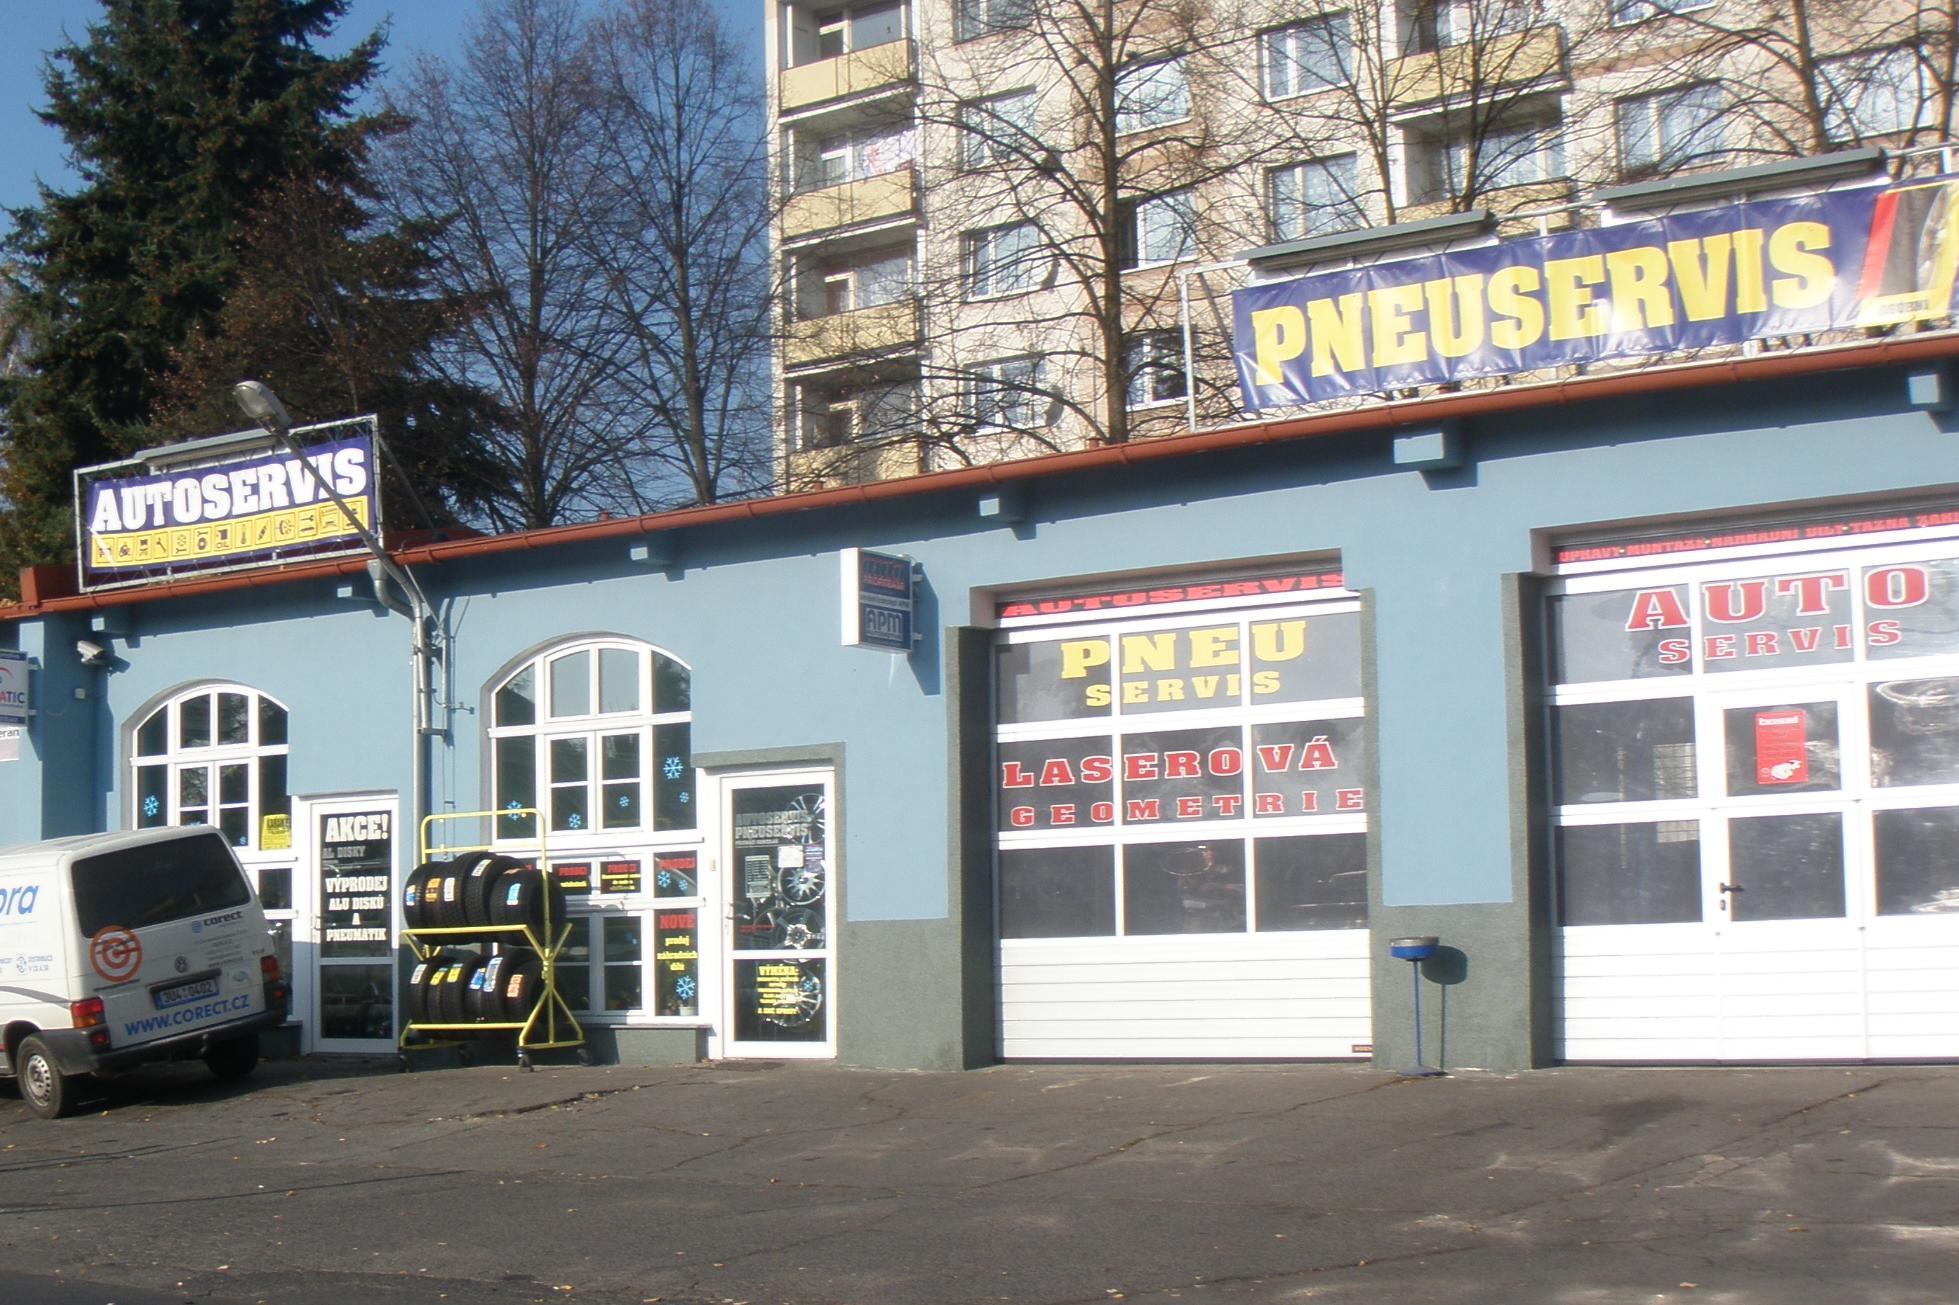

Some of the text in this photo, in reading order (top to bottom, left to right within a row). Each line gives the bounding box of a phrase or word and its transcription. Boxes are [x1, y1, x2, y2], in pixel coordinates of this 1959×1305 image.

[1252, 220, 1837, 387] PNEUSERVIS
[91, 447, 367, 532] AUTOSERVIS
[1002, 572, 1343, 617] AUTOSERVIS
[1625, 565, 1929, 633] AUTO
[1060, 620, 1306, 679] PNEU
[1658, 620, 1902, 664] SERVIS
[1086, 670, 1281, 707] SERVIS
[1002, 736, 1338, 788] LASEROVÁ
[325, 814, 389, 842] AKCE!
[1010, 788, 1364, 827] GEOMETRIE
[204, 910, 243, 927] corect
[352, 912, 361, 925] A
[124, 994, 250, 1036] WWW.CORECT.CZ
